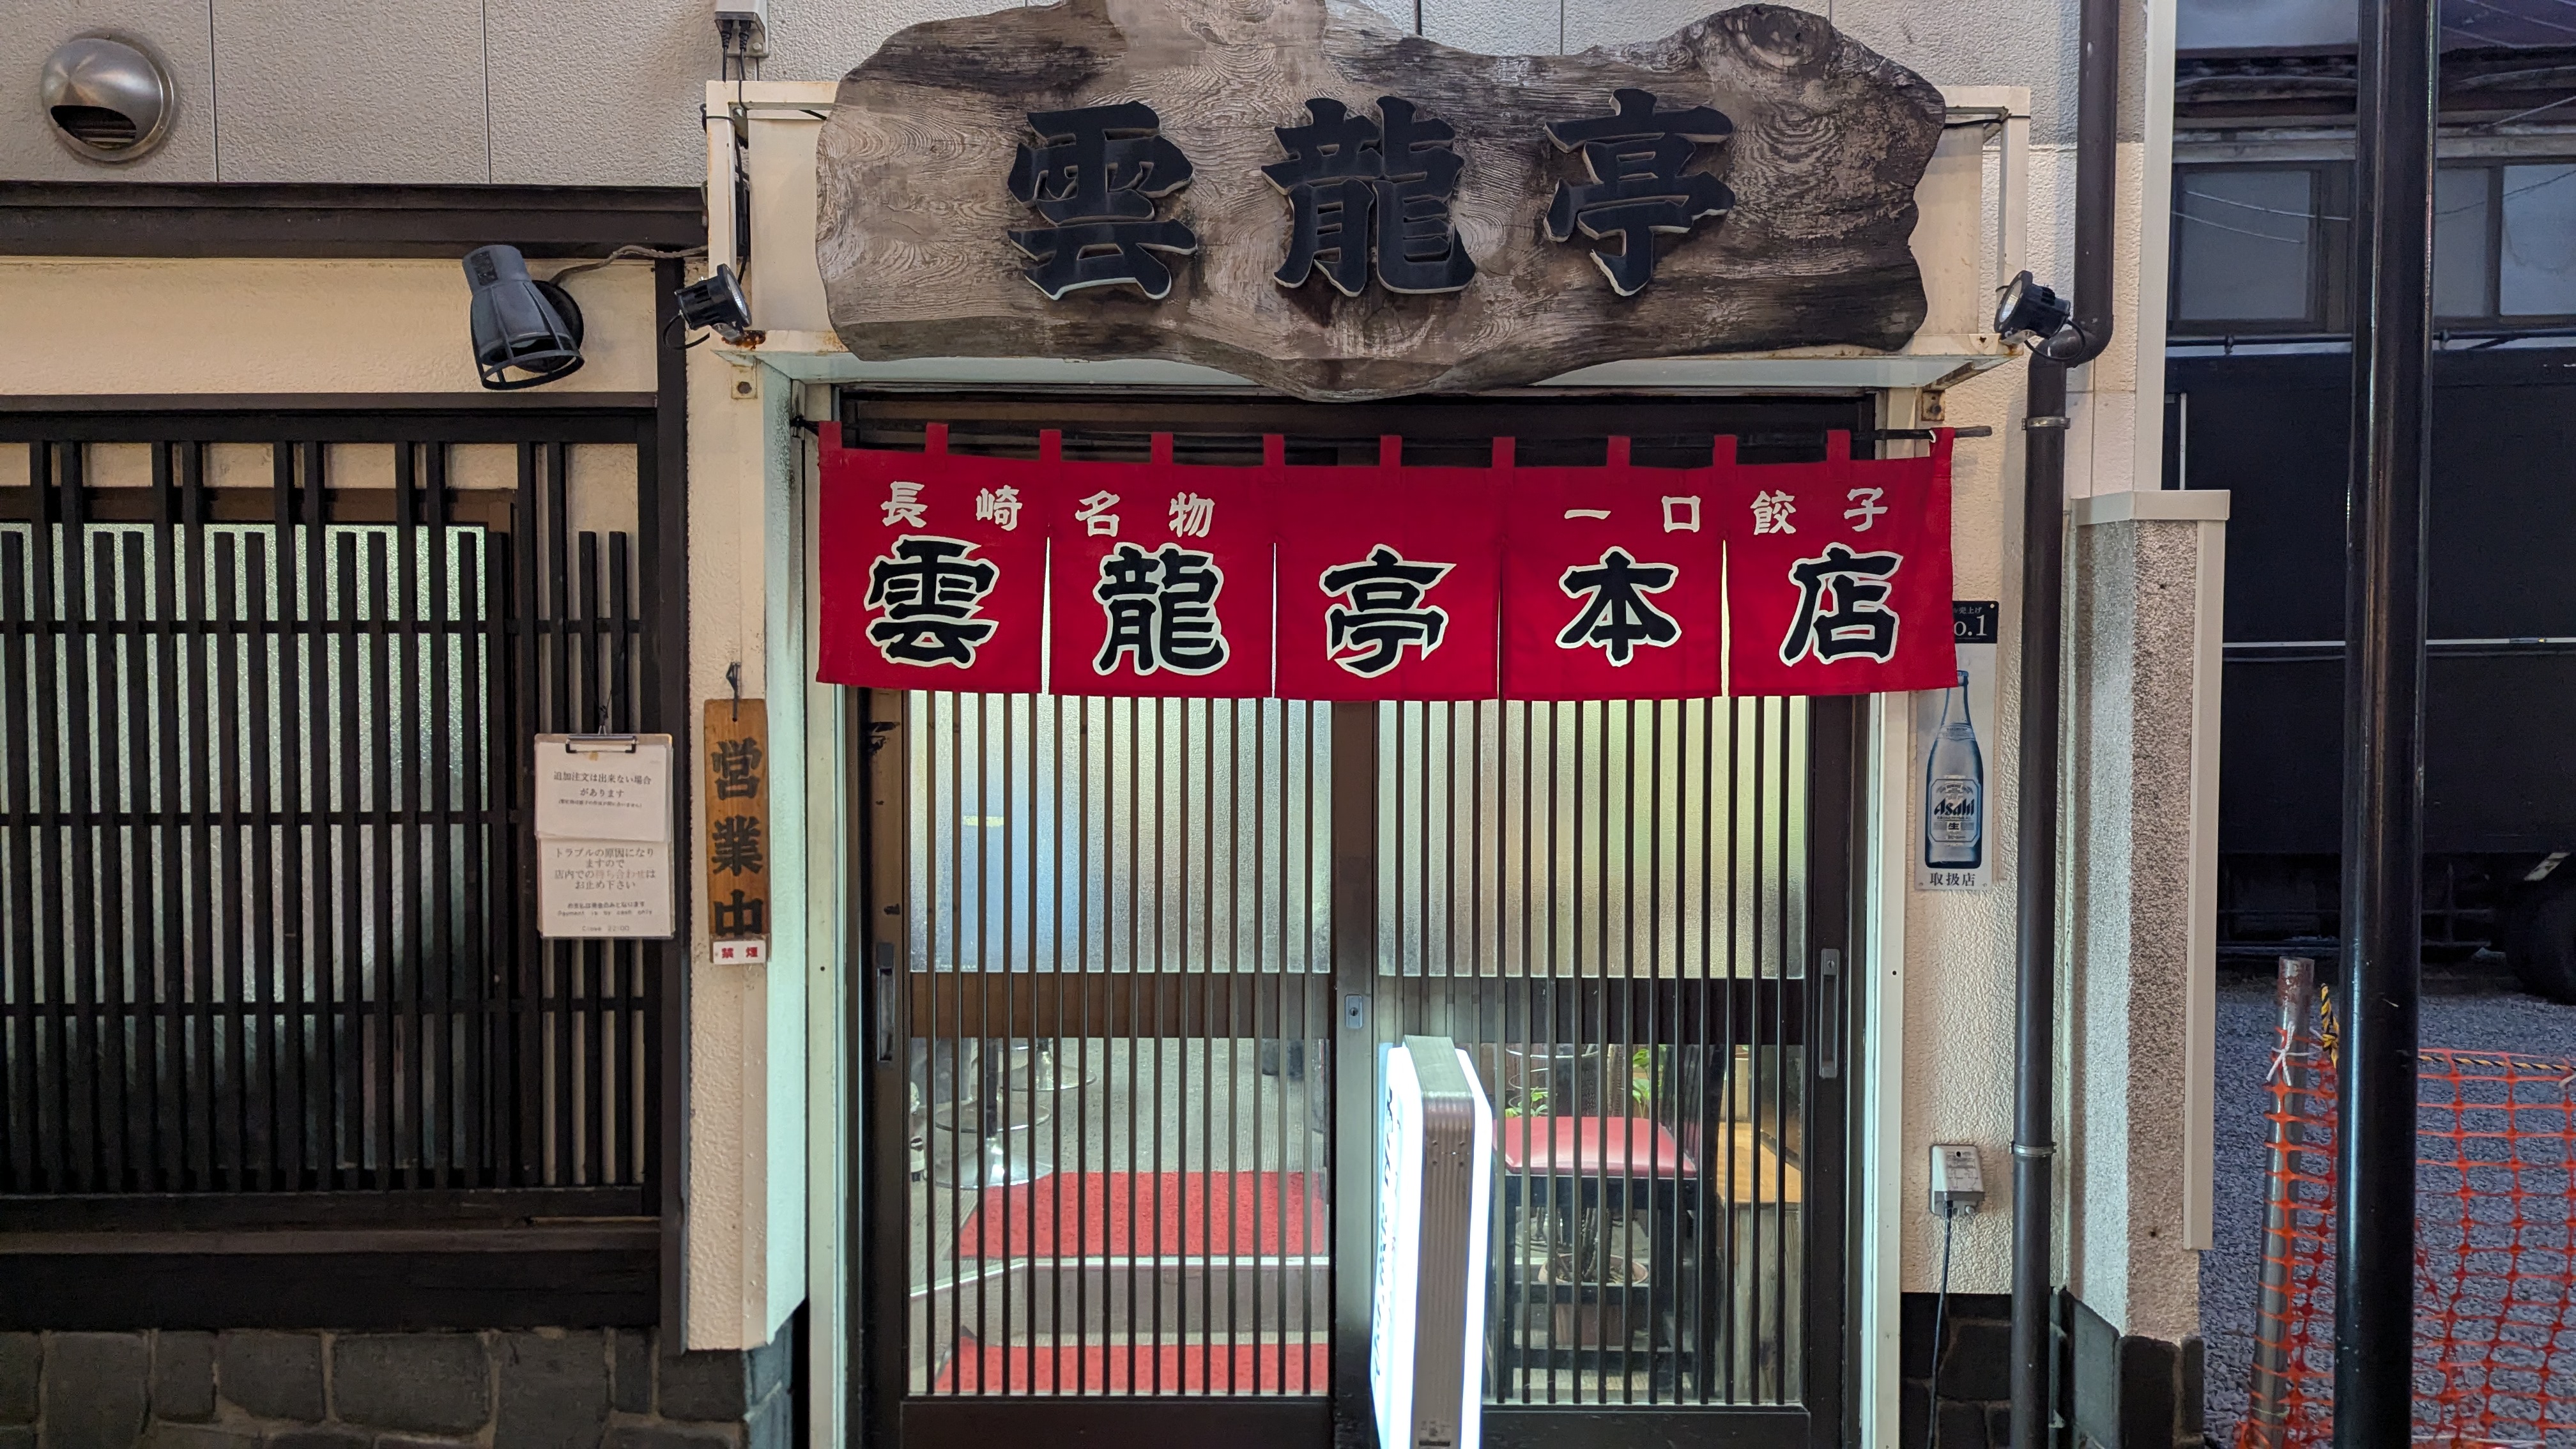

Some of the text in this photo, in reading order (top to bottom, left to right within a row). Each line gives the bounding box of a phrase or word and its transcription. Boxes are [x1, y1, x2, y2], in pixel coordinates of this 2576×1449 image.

[1008, 89, 1736, 300] 雲龍亭
[880, 480, 1889, 539] 長崎名物 一口餃子
[864, 535, 1903, 679] 雲龍亭本店
[1953, 614, 1988, 636] o.1
[553, 771, 652, 785] 追加注文は出来ない場合
[580, 788, 624, 798] があります
[1934, 798, 1975, 816] Asahi
[1948, 822, 1959, 831] 生
[711, 736, 764, 937] 営業中
[556, 848, 654, 858] トラブルの原因になり
[586, 858, 625, 868] ますので
[555, 869, 656, 880] 店内での待ち合わせは
[1929, 873, 1976, 887] 取扱店
[576, 880, 636, 890] お止め下さい
[721, 947, 758, 958] 禁煙
